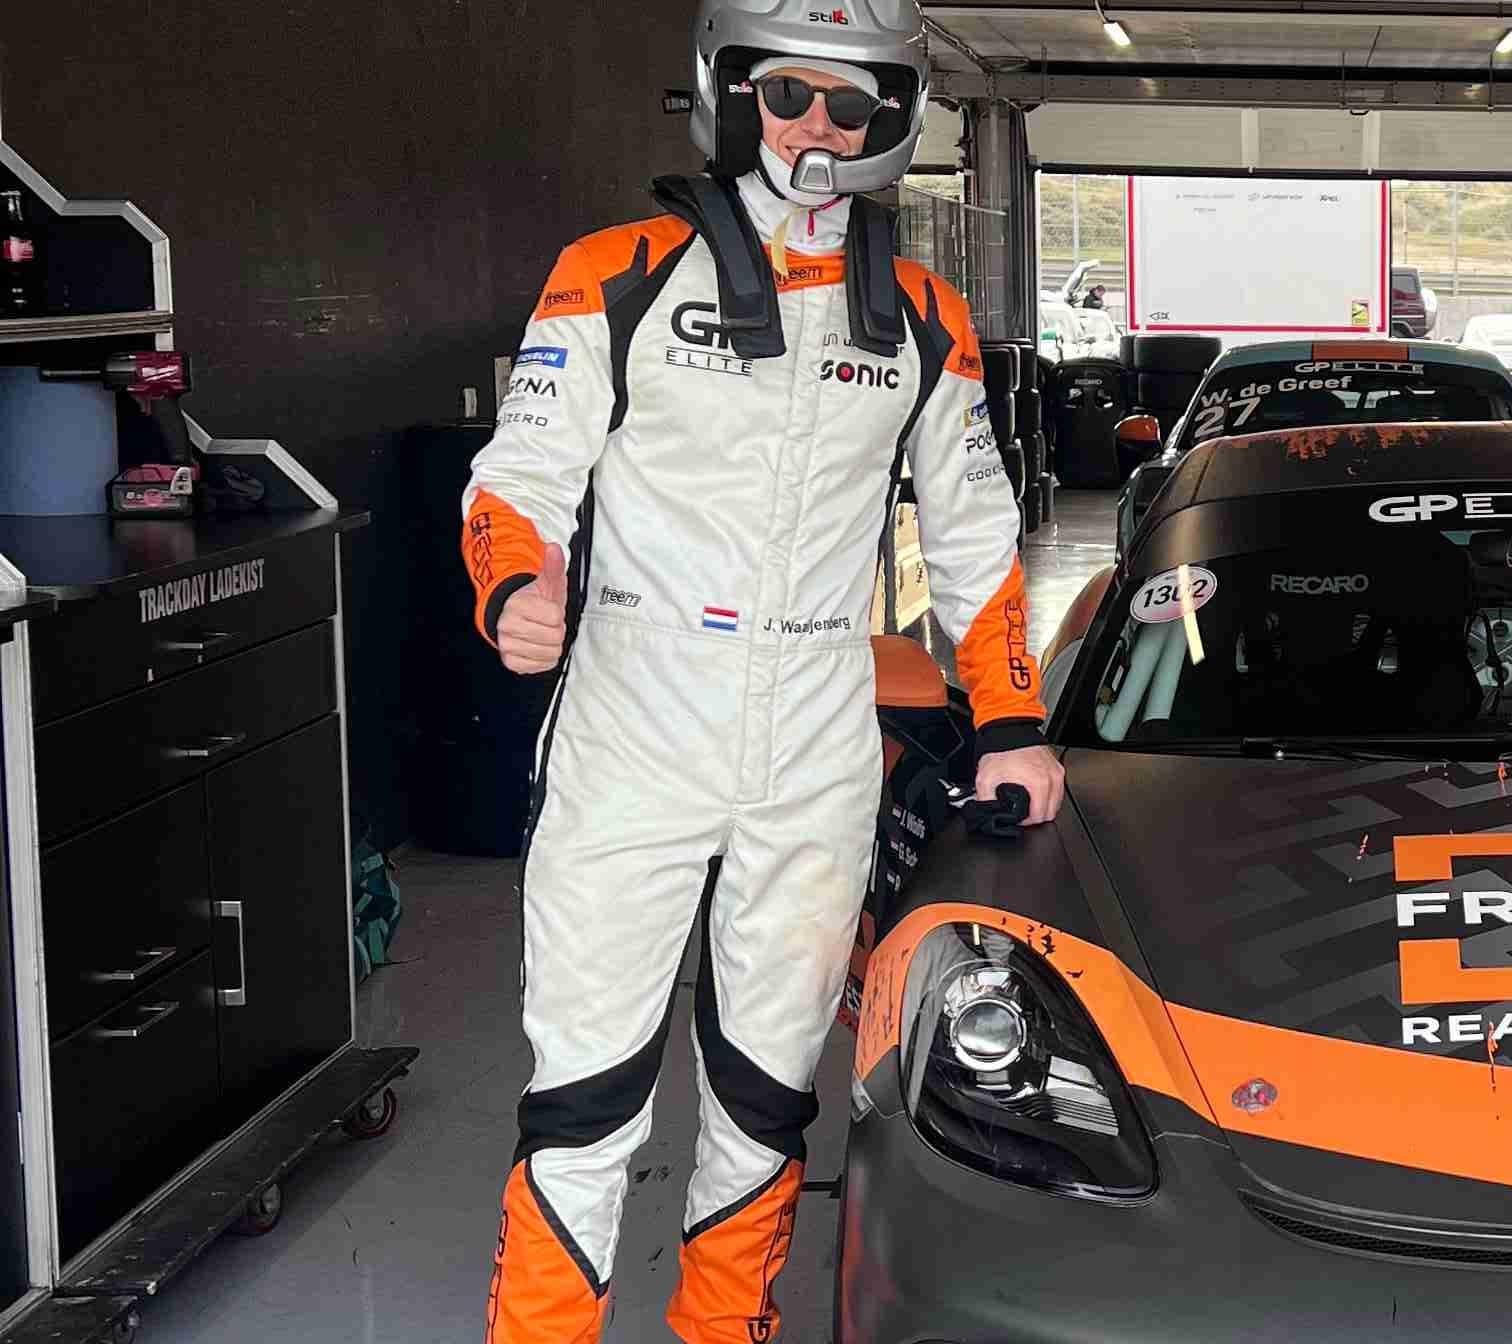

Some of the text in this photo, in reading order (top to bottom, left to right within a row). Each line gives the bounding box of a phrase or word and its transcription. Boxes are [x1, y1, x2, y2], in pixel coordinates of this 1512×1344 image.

[1201, 375, 1353, 408] W. de Greef
[1194, 396, 1261, 439] 27
[139, 558, 264, 623] TRACKDAY LADEKIST
[1268, 573, 1369, 595] RECARO
[764, 618, 776, 632] J.
